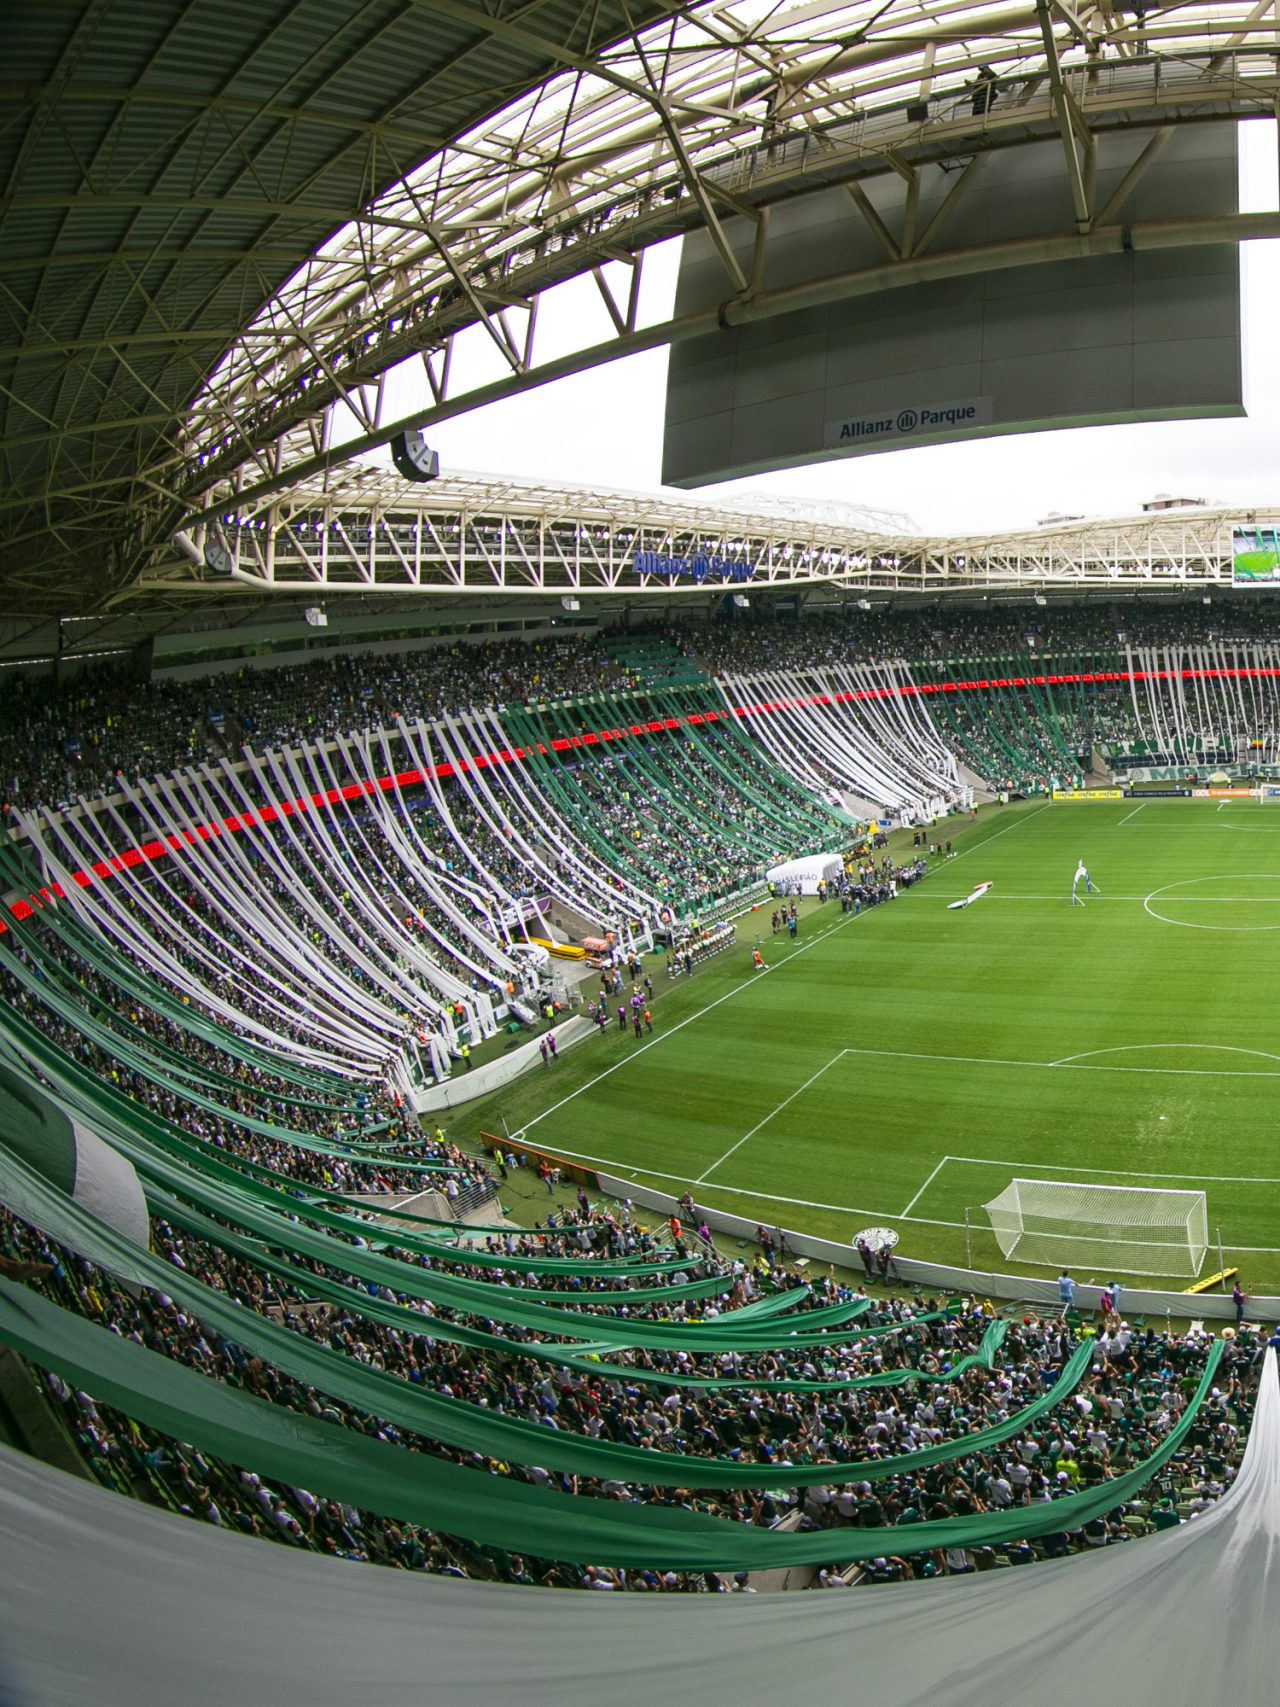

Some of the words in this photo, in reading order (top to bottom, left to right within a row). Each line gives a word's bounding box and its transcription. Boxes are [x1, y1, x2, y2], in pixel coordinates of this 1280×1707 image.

[840, 418, 893, 439] Allianz
[920, 406, 976, 425] Parque
[631, 551, 688, 575] Allianz
[712, 556, 755, 582] Parque
[1160, 1481, 1172, 1491] 10
